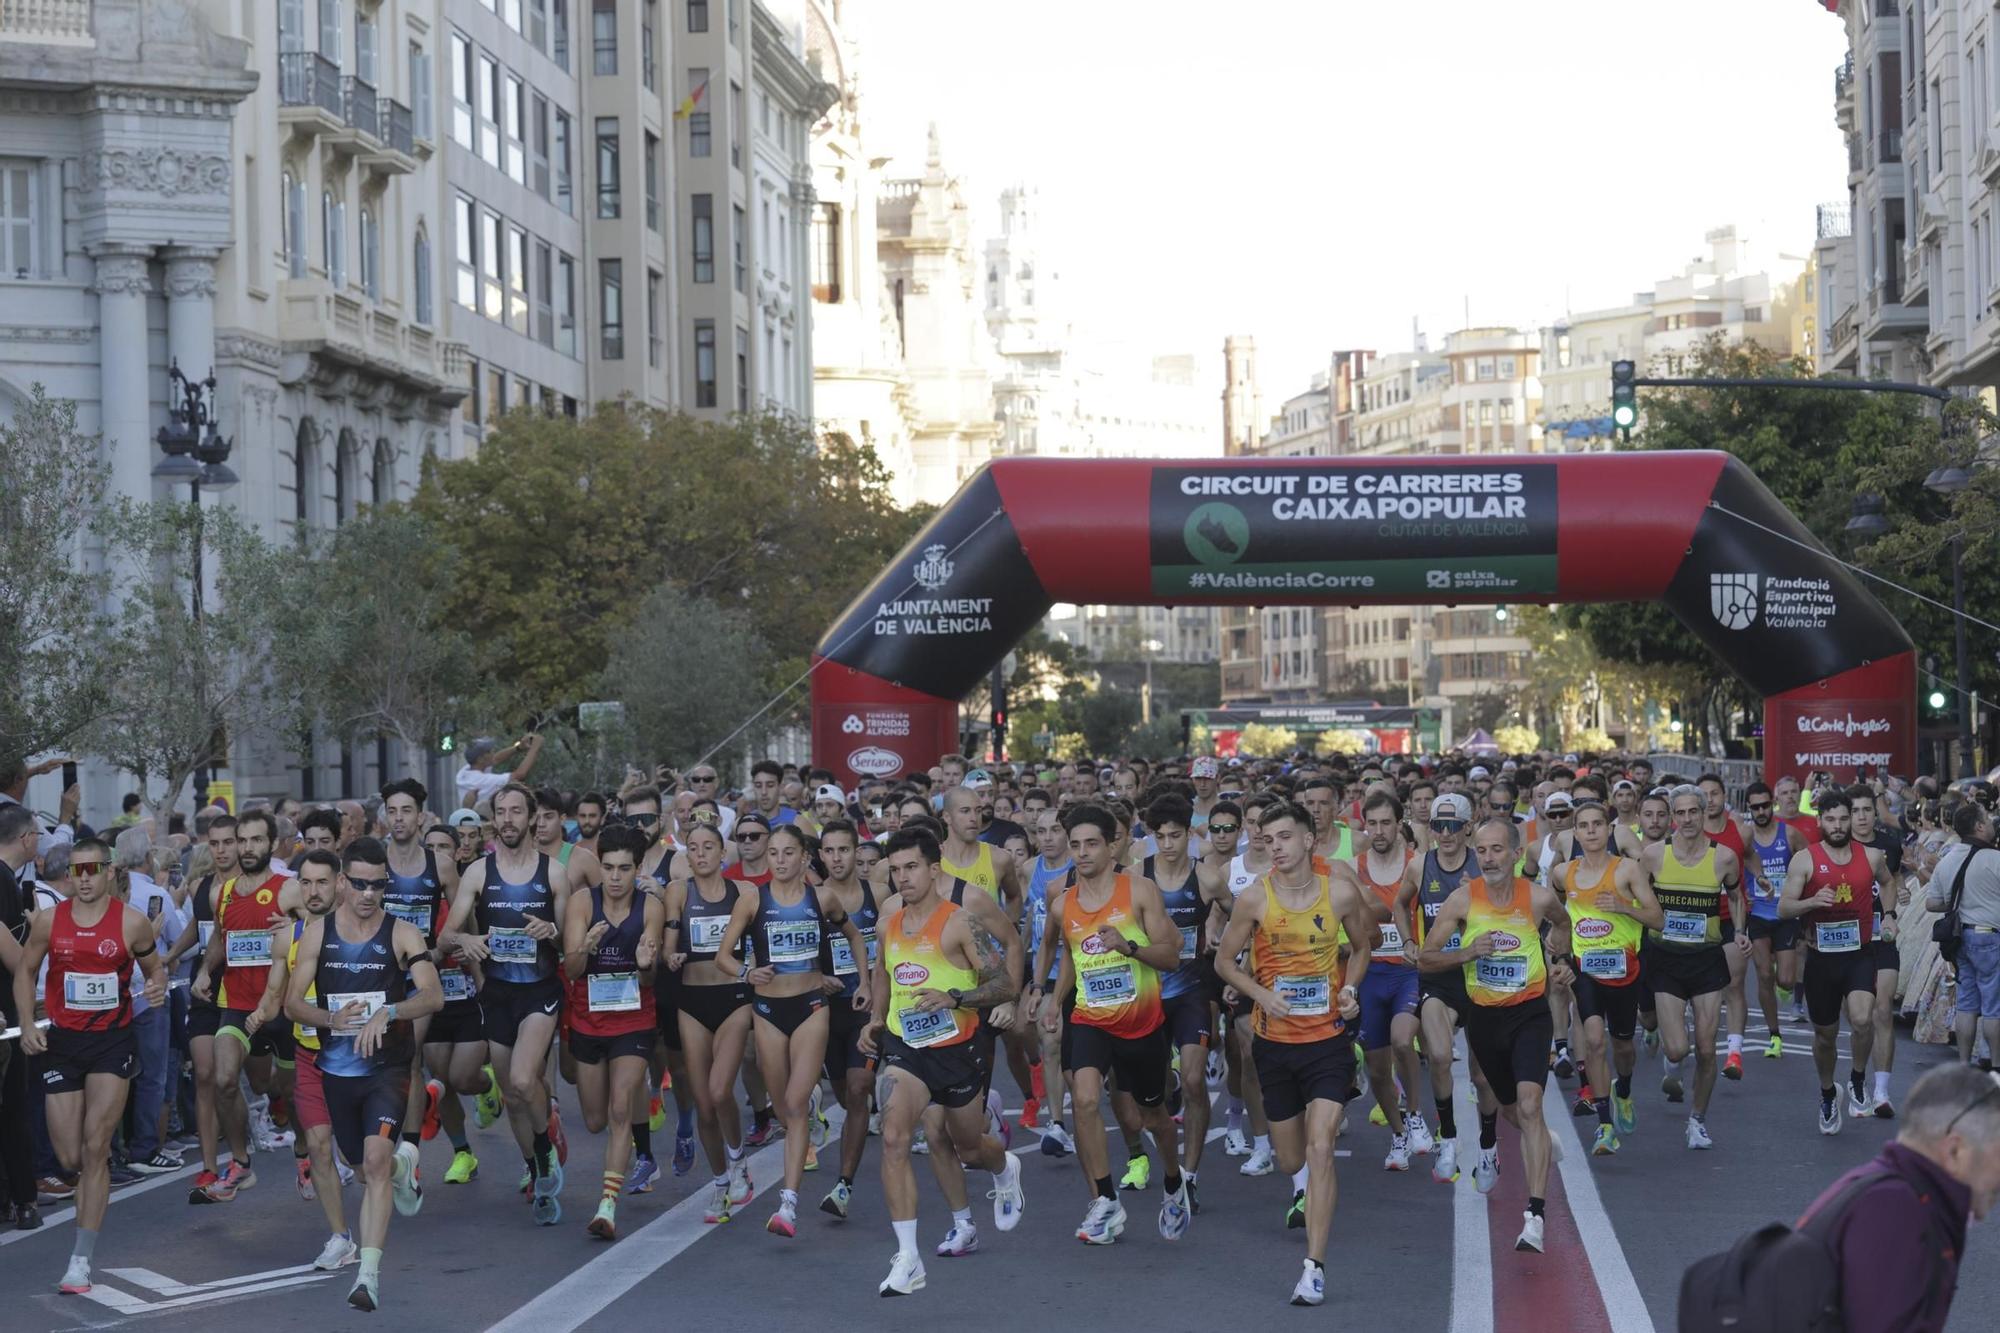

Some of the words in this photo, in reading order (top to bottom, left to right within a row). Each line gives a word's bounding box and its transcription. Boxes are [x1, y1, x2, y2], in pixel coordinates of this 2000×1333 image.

[1180, 476, 1300, 495] CIRCUIT
[1307, 476, 1348, 494] DE
[1354, 473, 1523, 494] CARRERES
[1378, 523, 1428, 537] CIUTAT
[1432, 523, 1453, 536] DE
[1188, 571, 1375, 588] #ValènciaCorre
[1454, 570, 1496, 579] caixa
[1454, 578, 1519, 588] popular
[1765, 577, 1830, 590] Fundació
[1765, 590, 1834, 604] Esportiva
[876, 598, 993, 617] AJUNTAMENT
[1765, 603, 1837, 617] Municipal
[874, 620, 897, 635] DE
[903, 615, 993, 635] VALÈNCIA
[1765, 615, 1828, 628] València
[866, 719, 910, 727] TRINIDAD
[1797, 716, 1811, 732] El
[1811, 716, 1845, 732] Corte
[866, 728, 910, 736] ALFONSO
[854, 754, 897, 768] Serrano
[1810, 753, 1893, 766] INTERSPORT
[1578, 923, 1610, 933] Serrano
[1668, 920, 1697, 931] 2067
[772, 931, 817, 947] 2158
[1823, 931, 1850, 941] 2193
[231, 941, 262, 952] 2233
[495, 938, 525, 950] 2122
[1586, 957, 1617, 968] 2259
[896, 968, 926, 980] Serrano
[1482, 964, 1515, 977] 2018
[86, 982, 106, 995] 31
[1089, 977, 1122, 992] 2036
[906, 1014, 940, 1032] 2320
